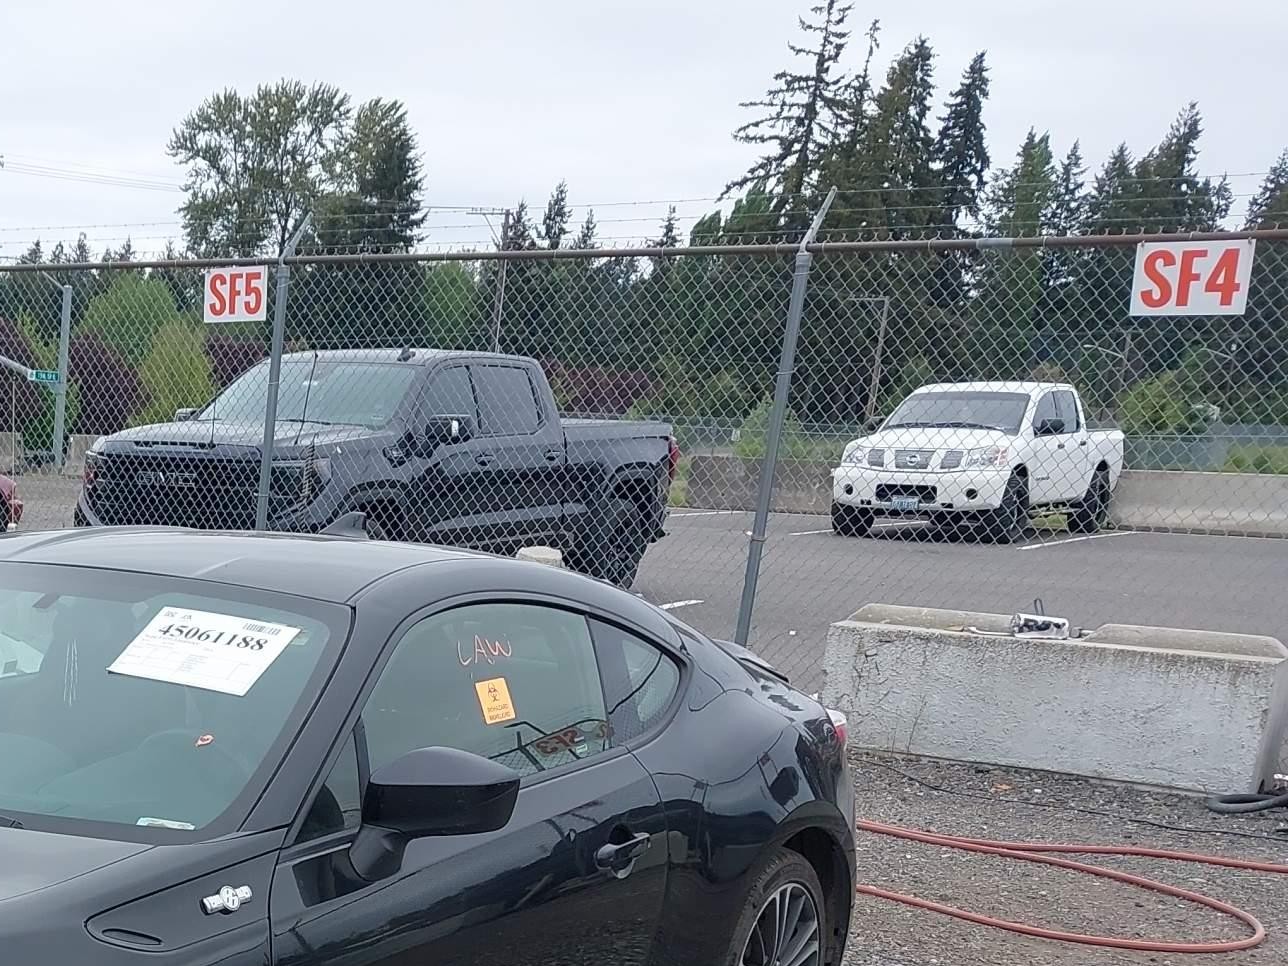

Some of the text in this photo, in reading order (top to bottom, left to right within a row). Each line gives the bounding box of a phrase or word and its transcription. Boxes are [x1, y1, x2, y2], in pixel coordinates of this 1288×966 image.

[208, 271, 262, 317] SF5
[1140, 248, 1241, 308] SF4
[158, 622, 269, 652] 45061188
[456, 633, 513, 666] LAW
